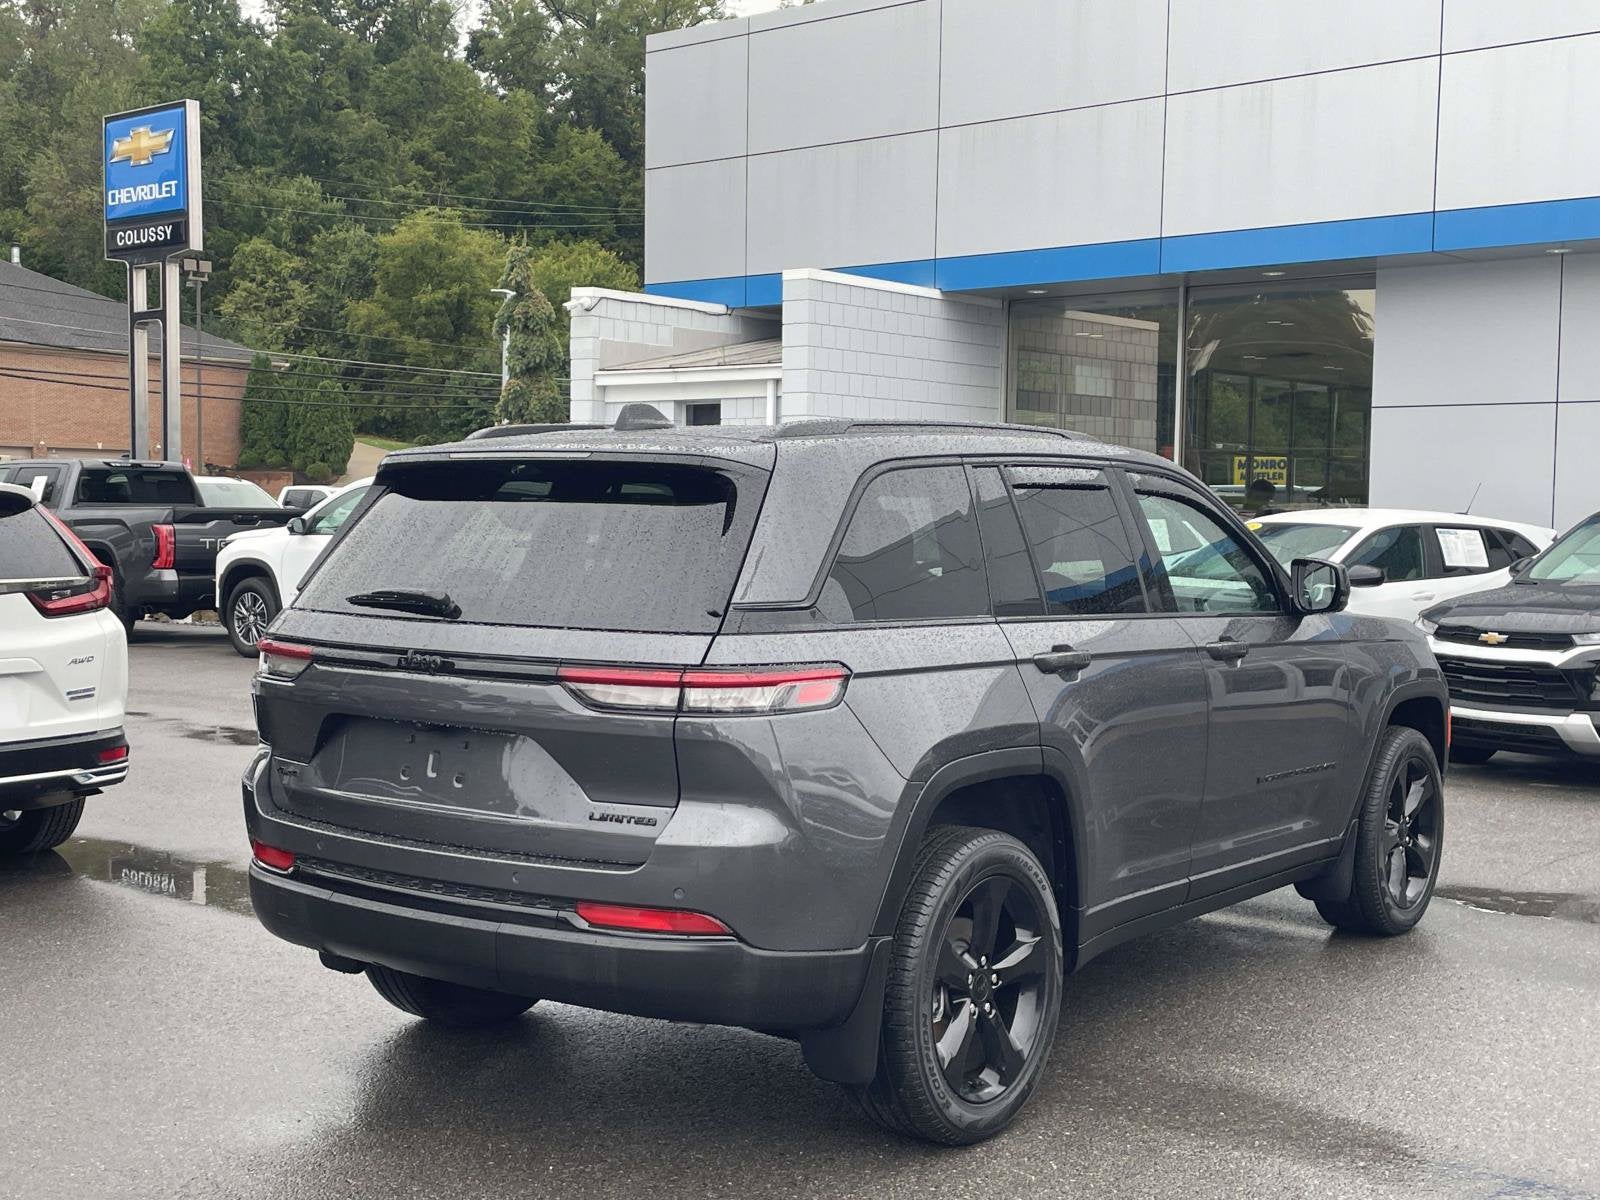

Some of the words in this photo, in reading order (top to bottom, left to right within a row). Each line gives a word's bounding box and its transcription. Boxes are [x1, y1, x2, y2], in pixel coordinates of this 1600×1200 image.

[108, 180, 178, 206] CHEVROLET
[116, 225, 173, 246] COLUSSY
[67, 655, 94, 666] AWD
[589, 812, 657, 827] LIMITED
